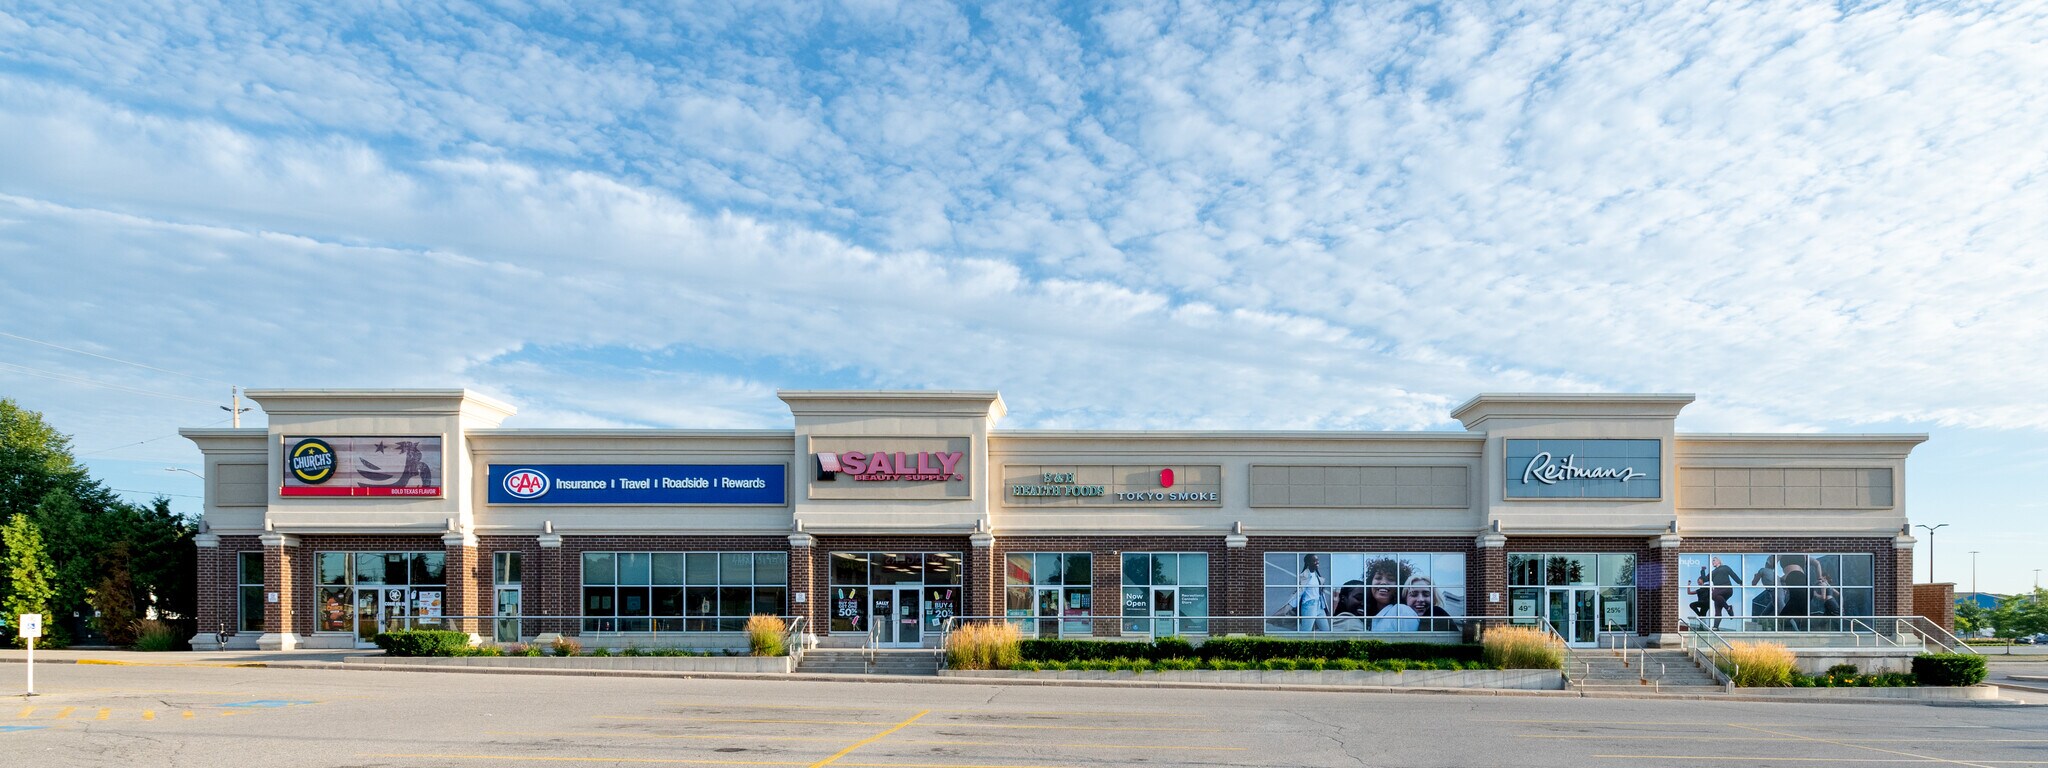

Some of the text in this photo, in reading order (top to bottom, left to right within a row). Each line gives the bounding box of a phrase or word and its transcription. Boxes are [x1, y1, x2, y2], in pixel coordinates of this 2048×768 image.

[293, 453, 332, 470] CHURCH'S
[841, 451, 963, 475] SALLY
[1522, 451, 1646, 484] Reitmans
[509, 473, 542, 493] CAA
[556, 477, 766, 489] Insurance Travel Roadside Rewards
[1044, 472, 1075, 484] S & H
[1012, 485, 1105, 496] HEALTH FOODS
[1117, 492, 1218, 500] TOKYO SMOKE
